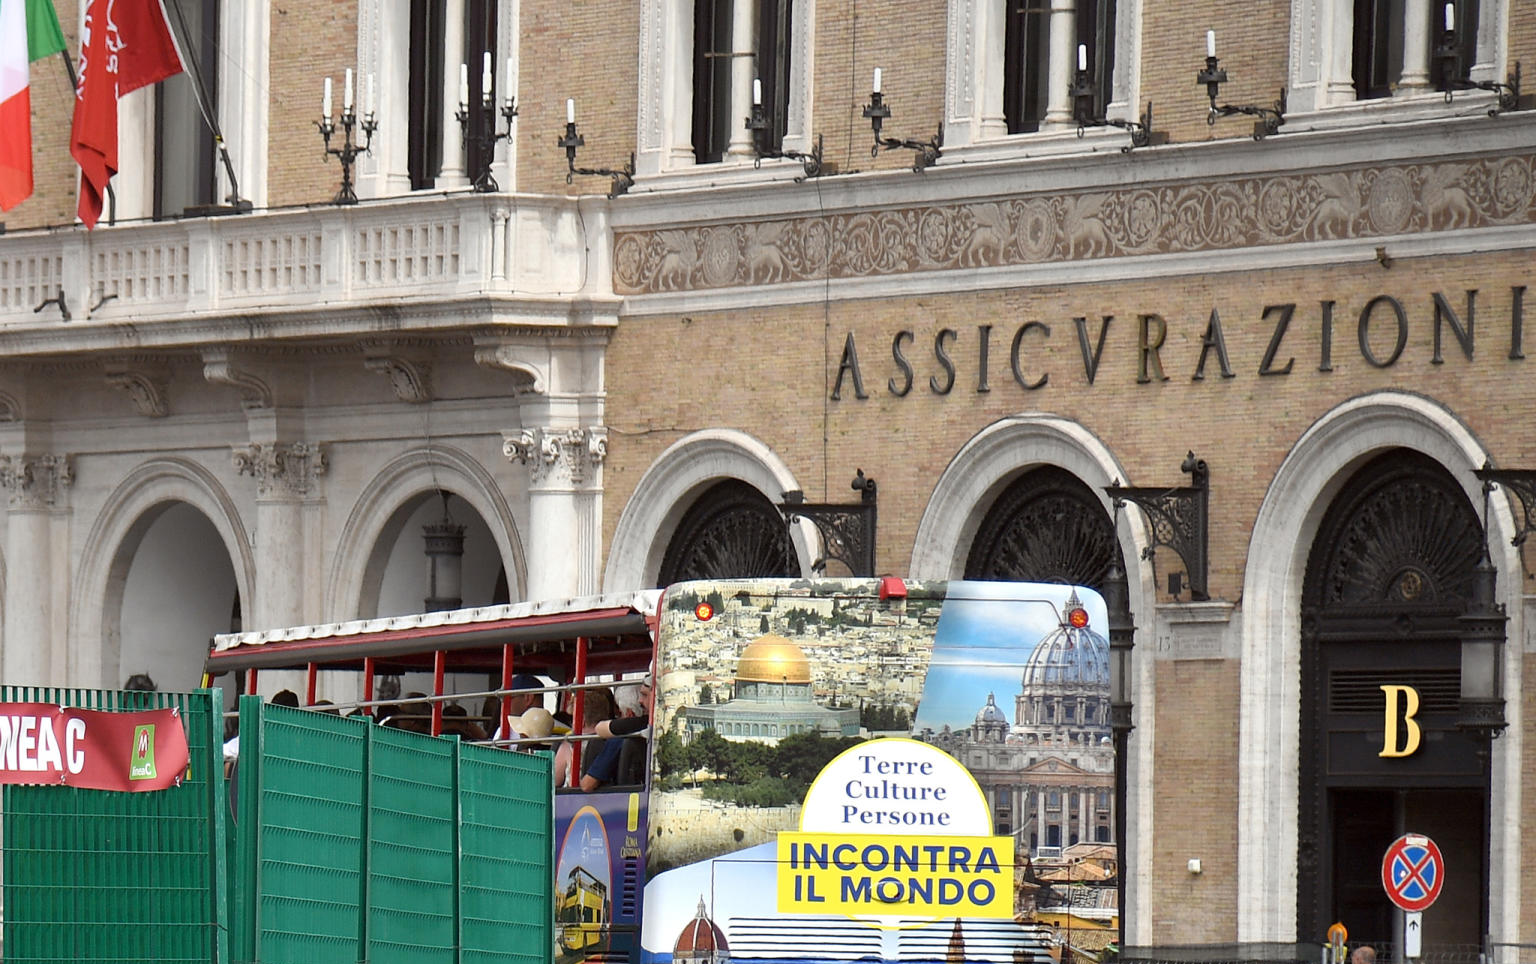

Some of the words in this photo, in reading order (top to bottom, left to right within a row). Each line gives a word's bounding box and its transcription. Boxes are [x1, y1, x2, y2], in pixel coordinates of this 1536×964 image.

[829, 285, 1528, 400] ASSICVRAZIONI
[1378, 685, 1421, 758] B
[65, 717, 86, 775] C
[858, 755, 933, 775] Terre
[845, 779, 947, 801] Culture
[841, 805, 951, 826] Persone
[790, 842, 1001, 874] INCONTRA
[794, 875, 825, 903] IL
[840, 875, 996, 906] MONDO
